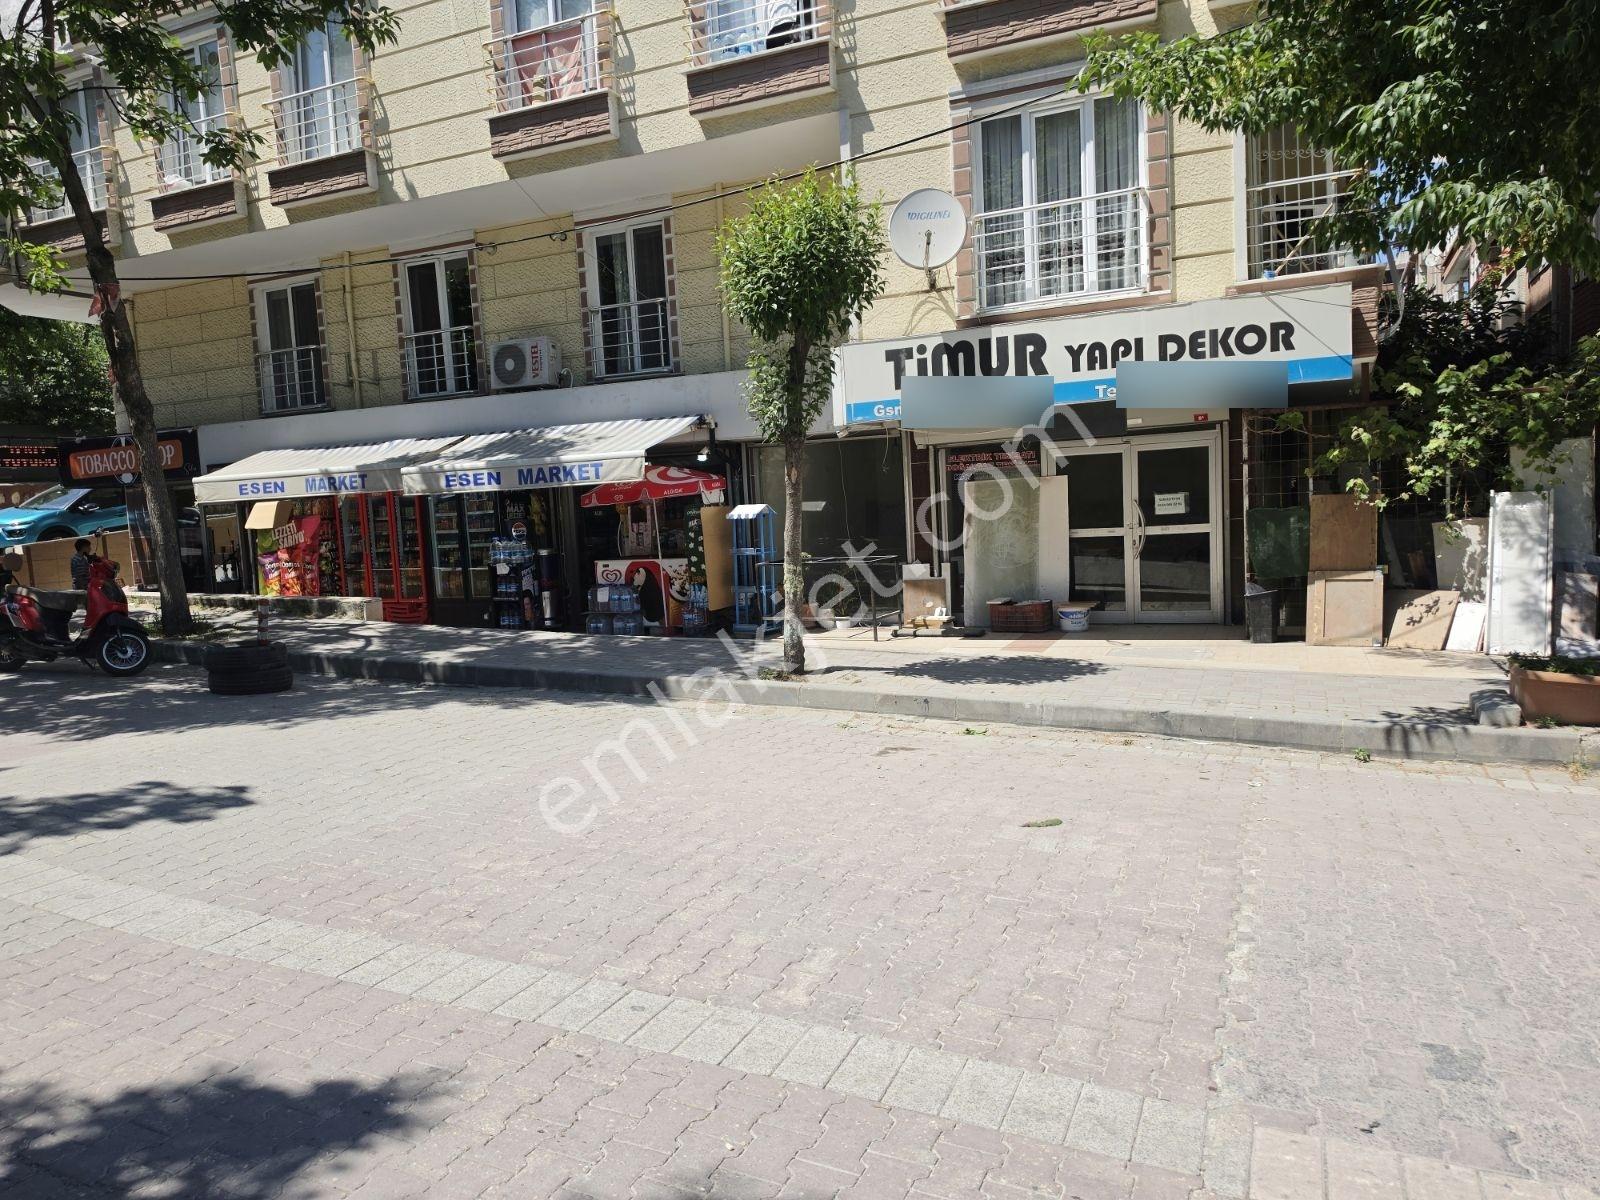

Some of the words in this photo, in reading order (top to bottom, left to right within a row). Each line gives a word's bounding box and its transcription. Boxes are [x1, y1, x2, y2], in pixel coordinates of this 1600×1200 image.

[1064, 337, 1144, 372] YAPI
[1158, 321, 1296, 361] DEKOR
[78, 449, 136, 475] TOBACCO
[445, 470, 502, 488] ESEN
[518, 462, 604, 485] MARKET
[239, 481, 285, 496] ESEN
[305, 473, 368, 492] MARKET
